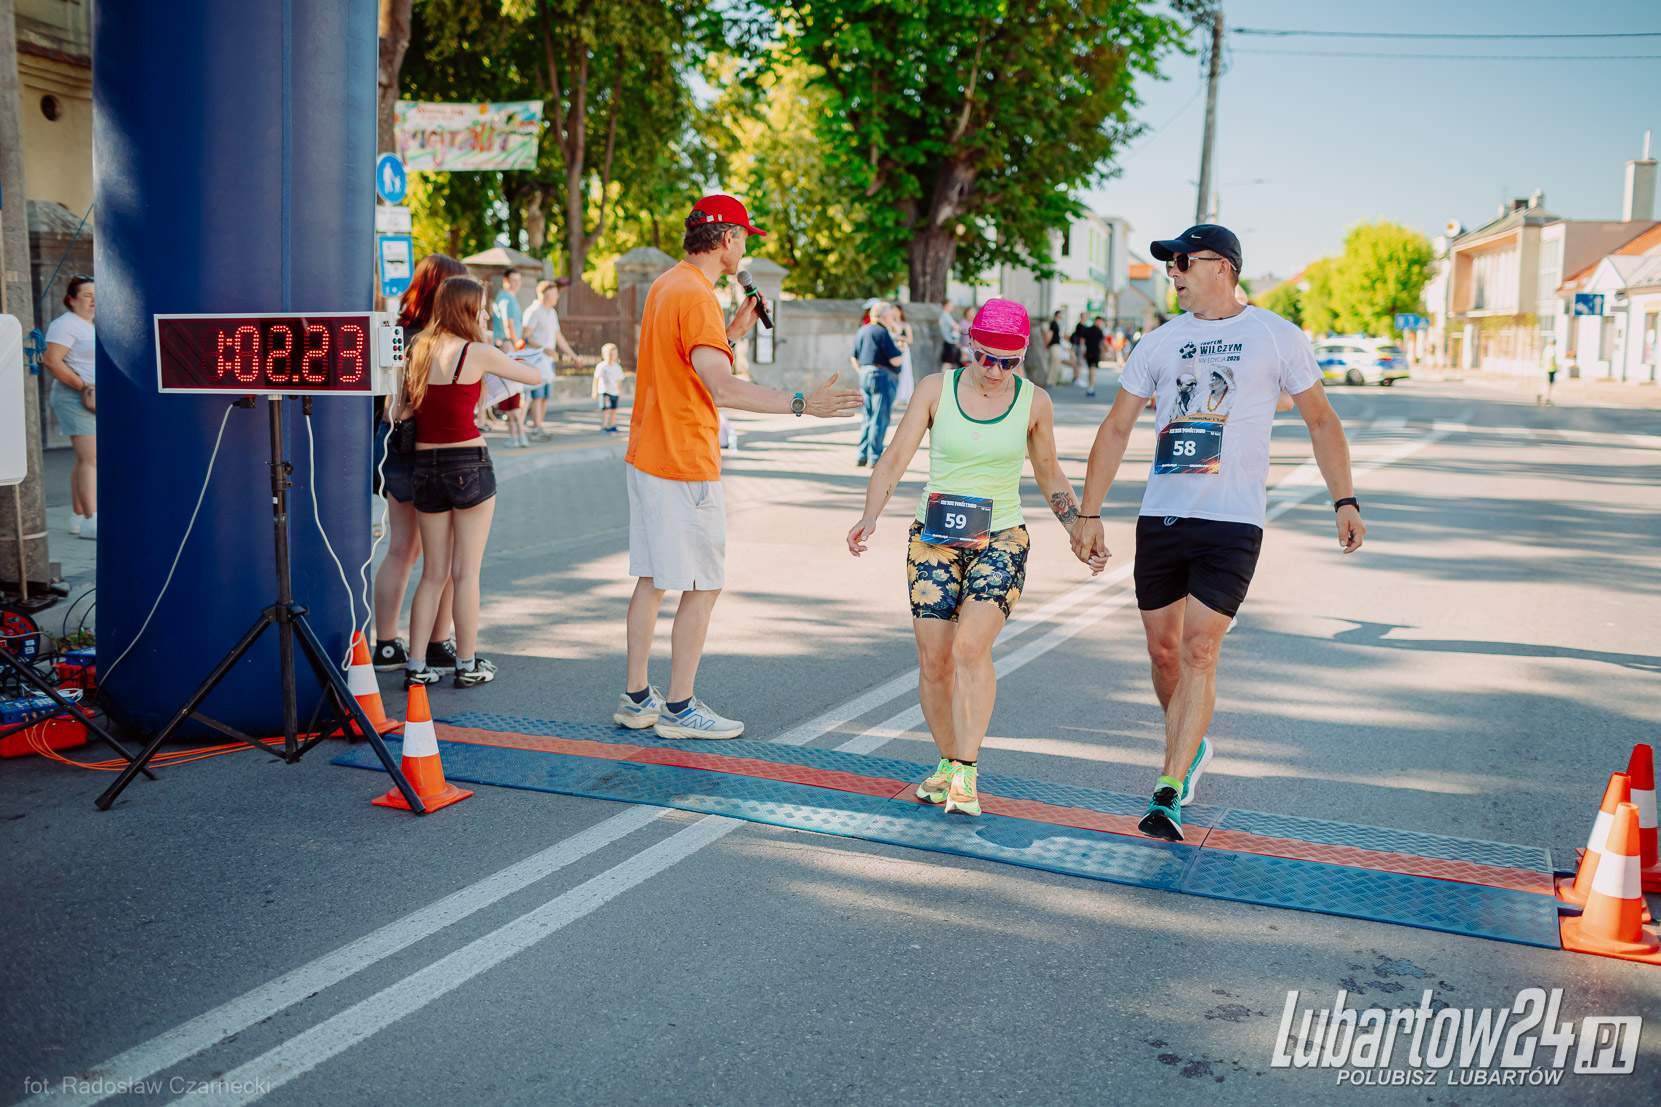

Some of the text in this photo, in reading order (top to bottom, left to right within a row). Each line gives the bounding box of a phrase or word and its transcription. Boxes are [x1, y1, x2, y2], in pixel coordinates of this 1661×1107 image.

[1200, 343, 1242, 355] WILCZYM
[1172, 440, 1196, 456] 58
[944, 512, 967, 529] 59
